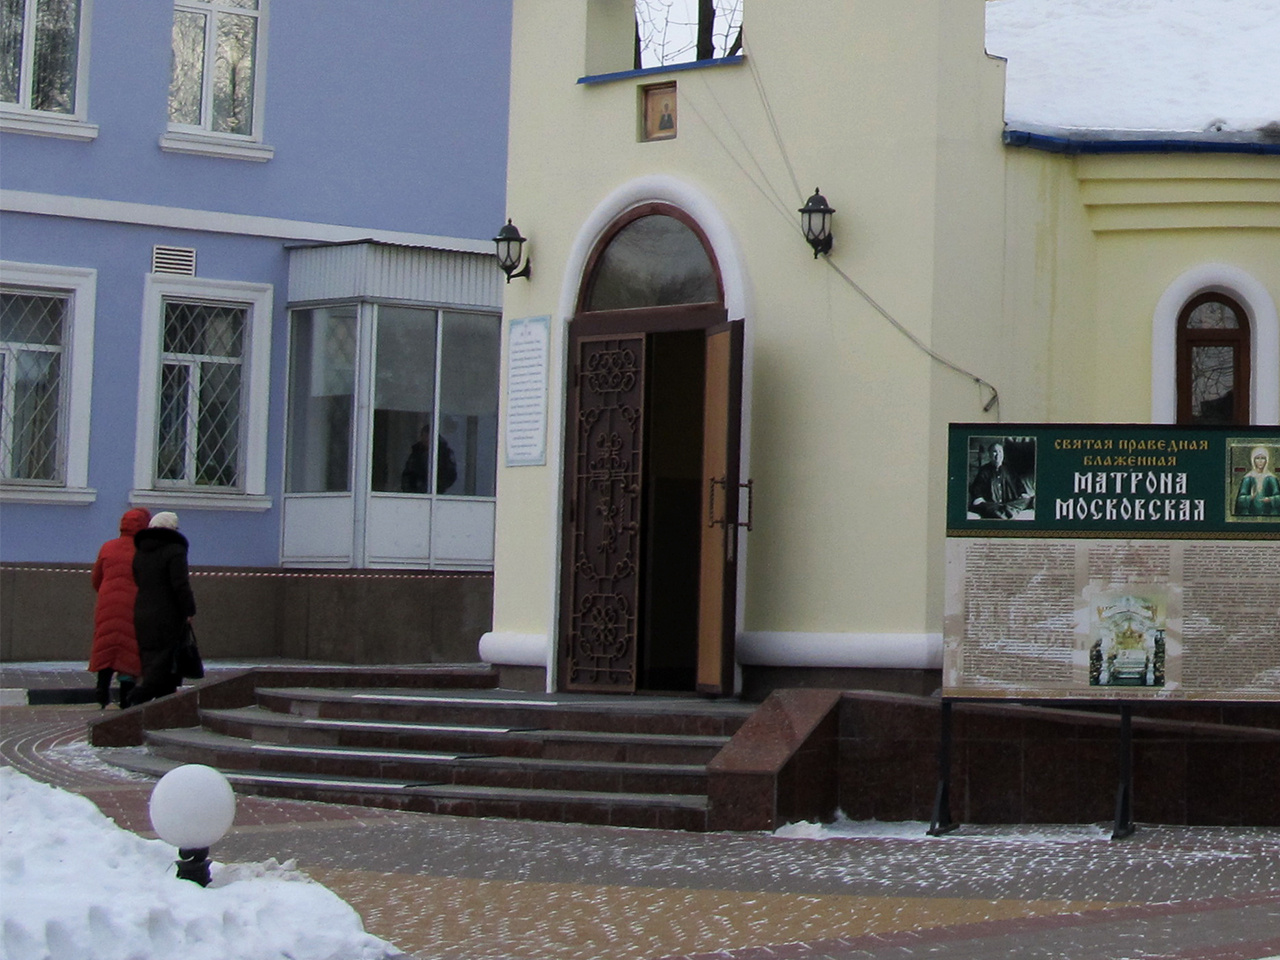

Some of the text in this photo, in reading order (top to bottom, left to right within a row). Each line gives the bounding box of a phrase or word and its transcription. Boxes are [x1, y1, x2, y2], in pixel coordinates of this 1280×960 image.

[1054, 439, 1209, 454] СВЯТАЯ ПРАВЕДНАЯ
[1083, 455, 1177, 467] БЛАЖЕННАЯ
[1074, 471, 1188, 494] МАТРОНА
[1055, 497, 1205, 521] МОСКОВСКАЯ
